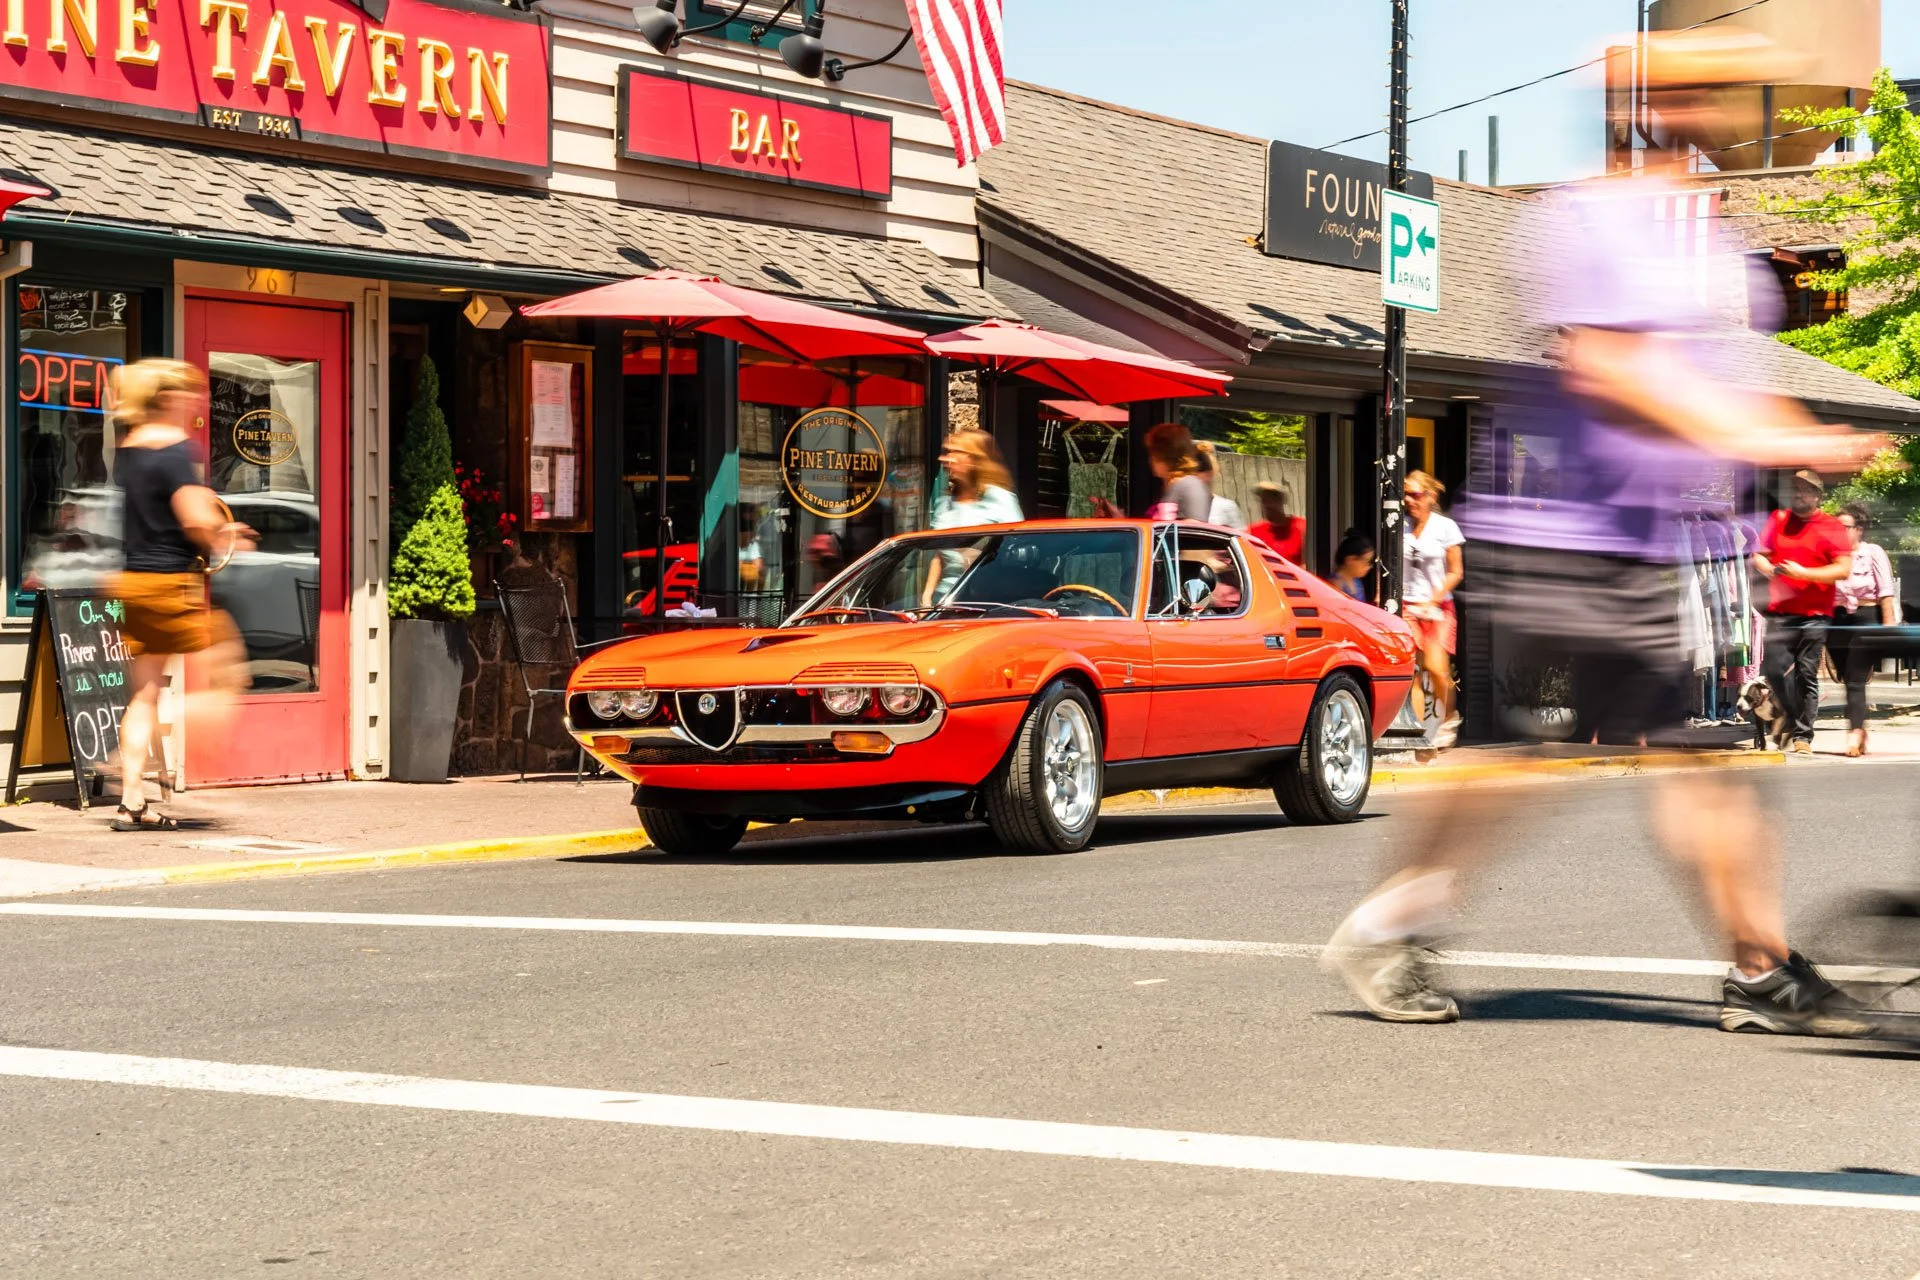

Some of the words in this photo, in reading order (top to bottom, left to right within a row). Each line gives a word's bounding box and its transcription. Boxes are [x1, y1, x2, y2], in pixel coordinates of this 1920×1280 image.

[2, 0, 160, 66] INE
[200, 0, 509, 125] TAVERN
[213, 109, 242, 126] EST
[258, 115, 291, 134] 1936
[729, 108, 802, 163] BAR
[1305, 168, 1381, 222] FOUN
[247, 265, 297, 296] 967
[20, 353, 120, 410] OPEN
[238, 429, 259, 440] PINE
[260, 431, 292, 442] TAVERN
[804, 418, 821, 432] THE
[823, 416, 863, 434] ORIGINAL
[789, 447, 824, 469] PINE
[826, 449, 878, 471] TAVERN
[798, 483, 849, 508] RESTAURANT
[855, 486, 872, 504] BAR
[79, 600, 106, 625] Our
[59, 633, 97, 664] River
[75, 675, 93, 692] is
[98, 671, 124, 688] now
[74, 706, 153, 762] OPE
